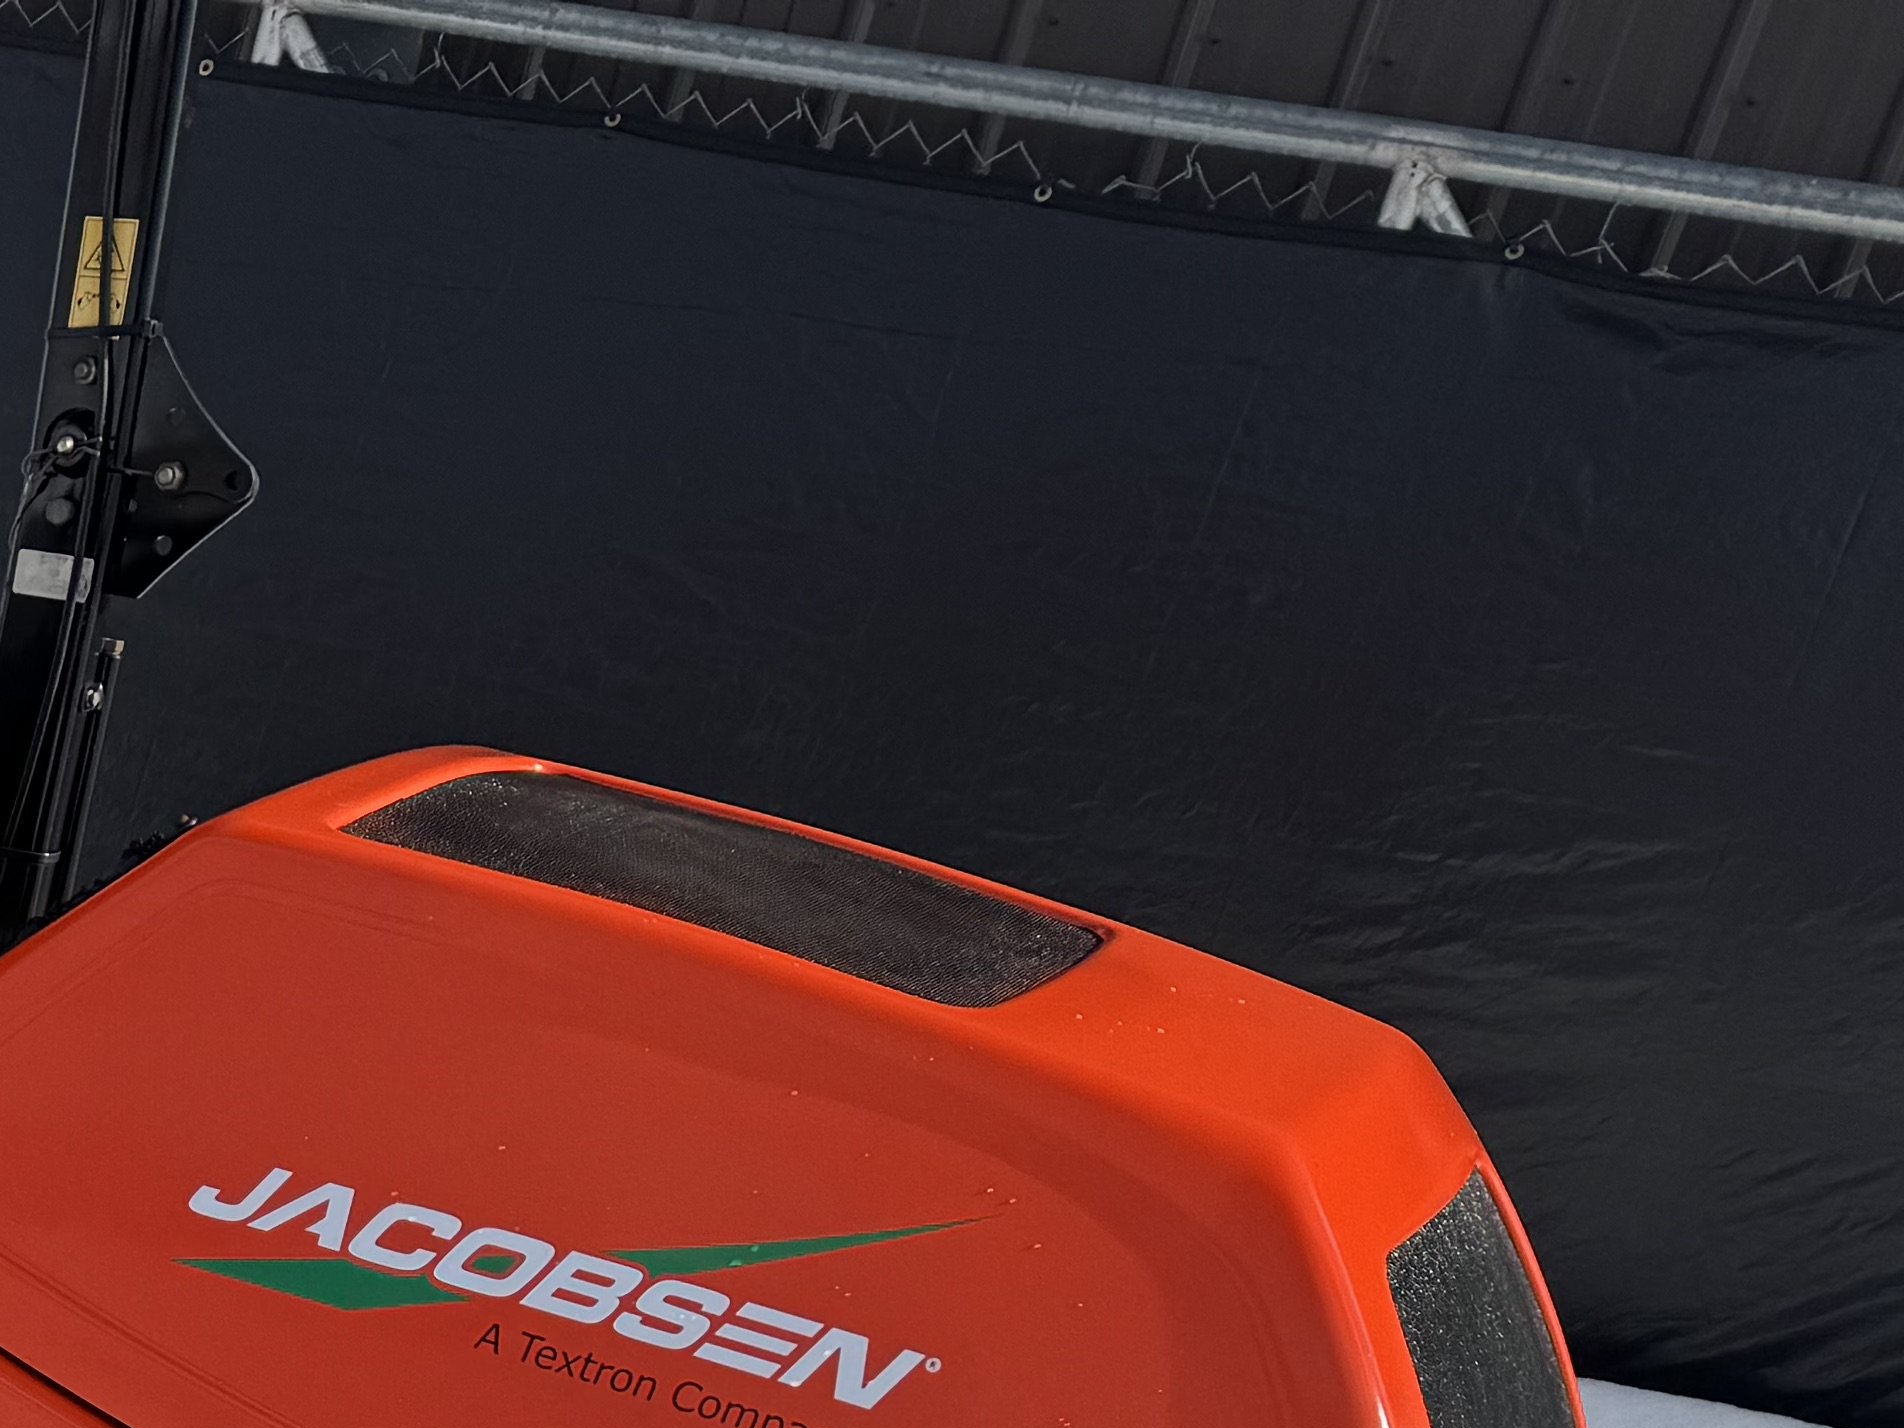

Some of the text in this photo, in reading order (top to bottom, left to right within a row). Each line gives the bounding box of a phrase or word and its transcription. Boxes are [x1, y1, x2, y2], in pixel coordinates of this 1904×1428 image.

[188, 1168, 926, 1410] JACOBSEN
[474, 1323, 502, 1356] A
[520, 1330, 657, 1404] Textron
